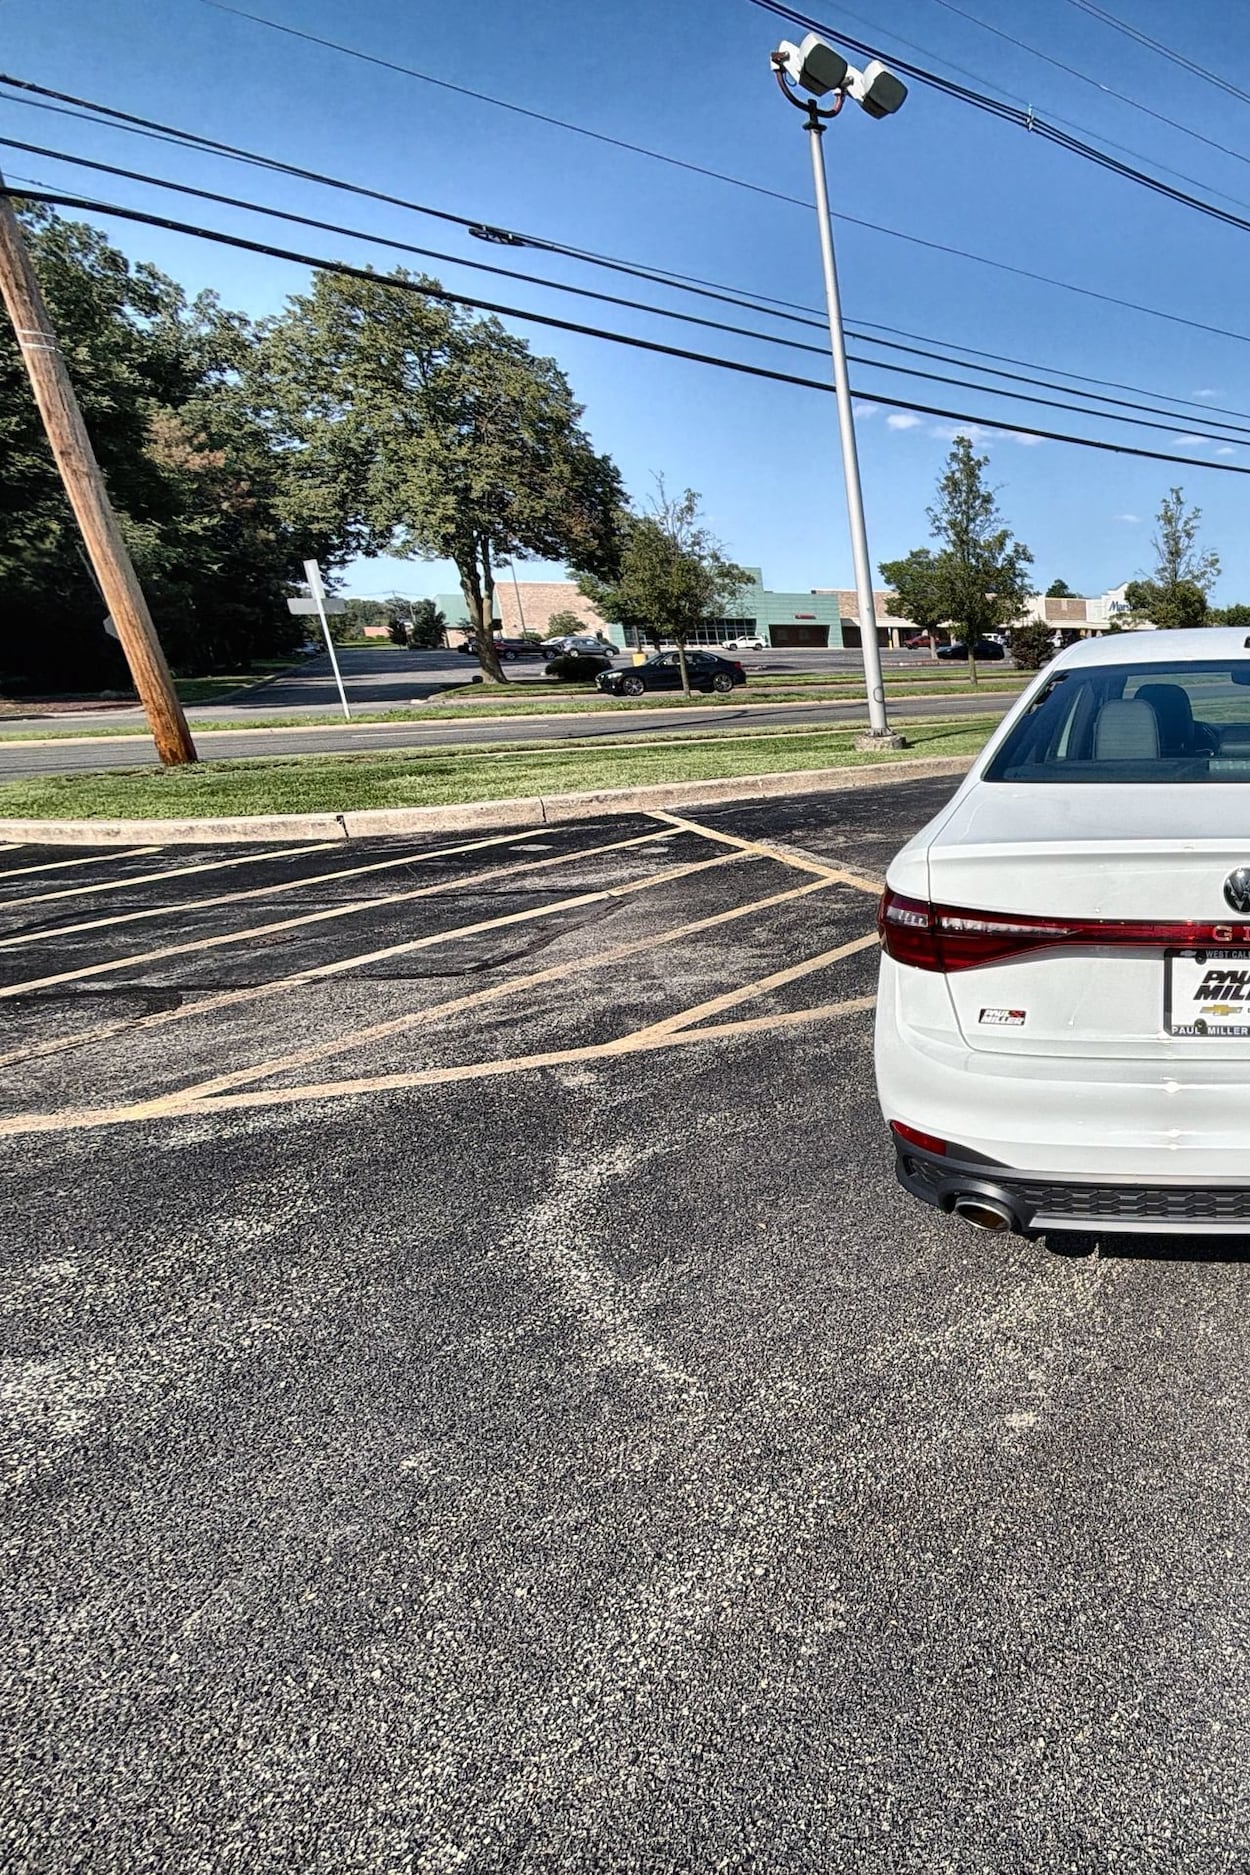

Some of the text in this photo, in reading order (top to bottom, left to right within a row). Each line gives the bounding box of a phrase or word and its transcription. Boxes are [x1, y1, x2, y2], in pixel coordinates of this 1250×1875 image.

[1205, 950, 1230, 959] WEST
[984, 1009, 1010, 1017] PAUL
[981, 1016, 1025, 1024] MILLER
[1171, 1026, 1200, 1035] PAUL
[1207, 1026, 1248, 1035] MILLER
